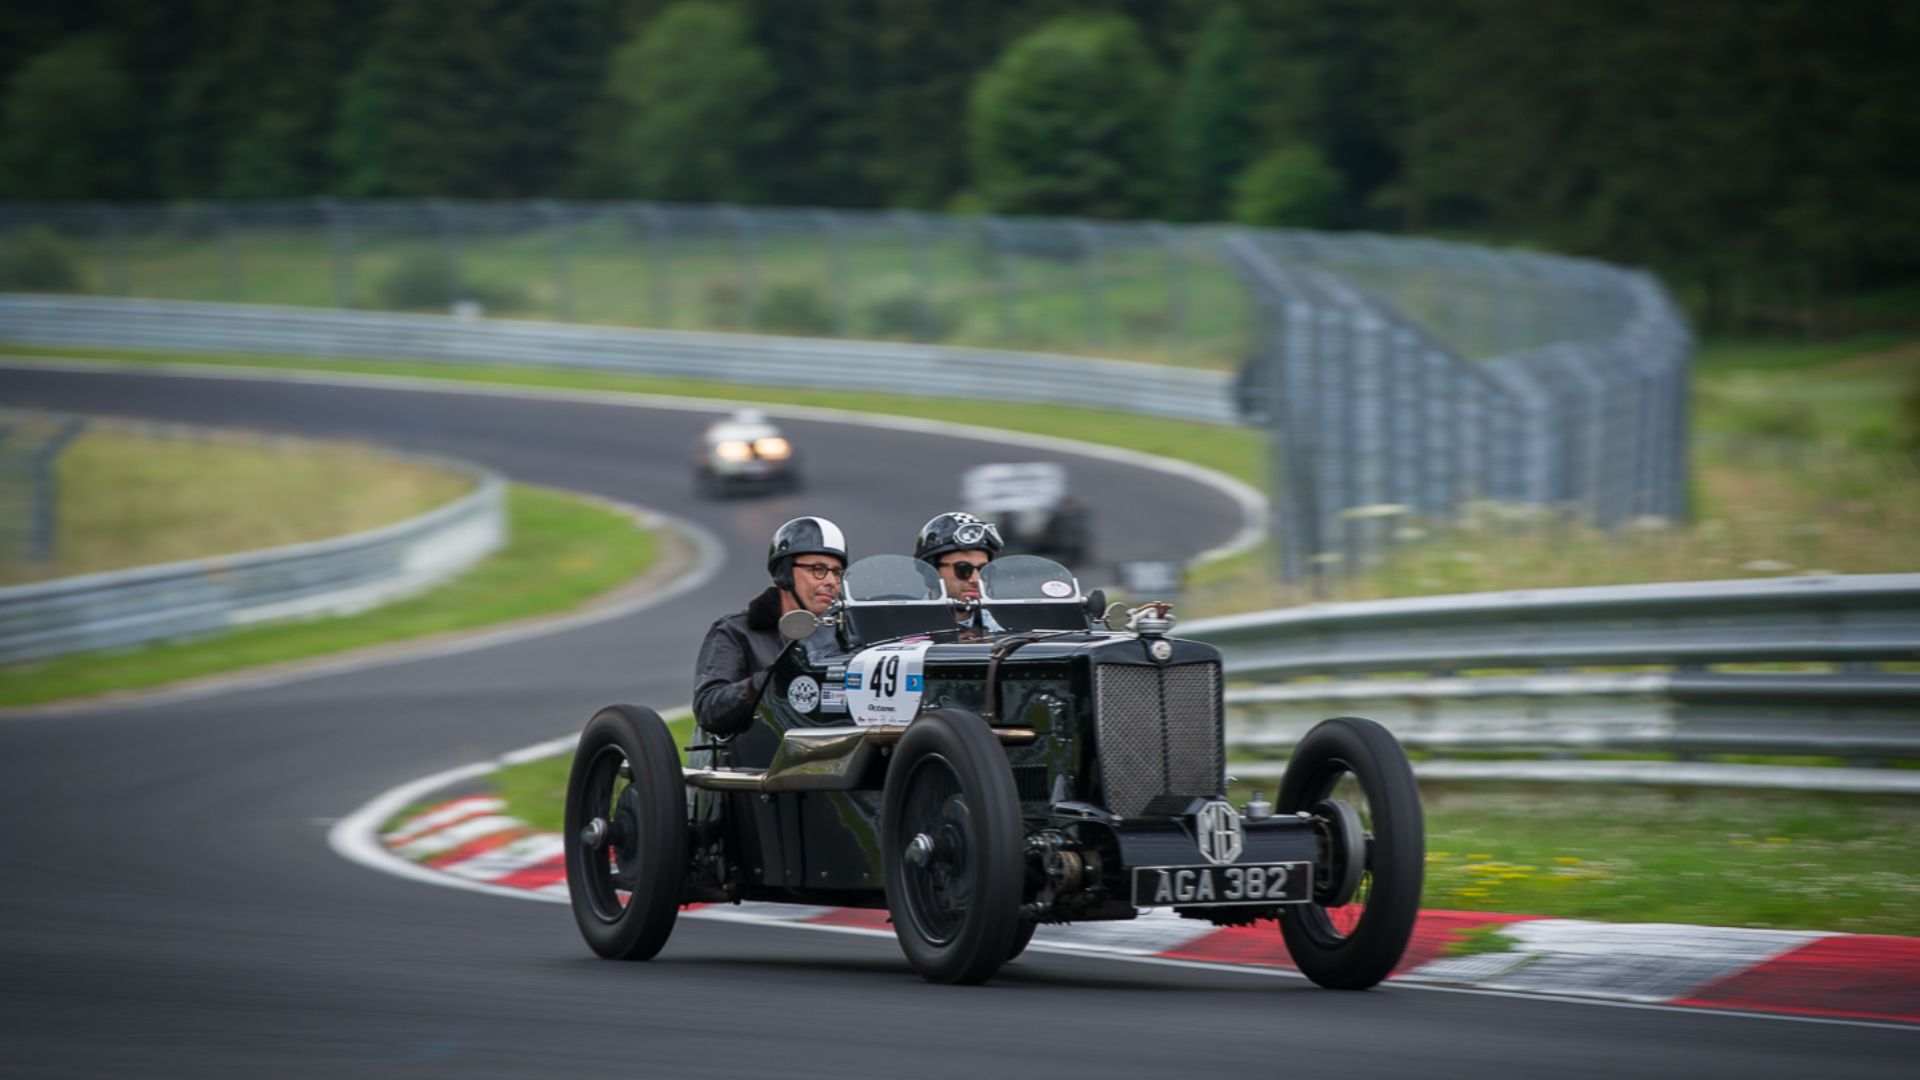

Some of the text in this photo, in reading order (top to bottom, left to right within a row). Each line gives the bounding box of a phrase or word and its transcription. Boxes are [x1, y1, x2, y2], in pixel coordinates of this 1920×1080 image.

[870, 655, 899, 698] 49
[1197, 801, 1242, 864] MG
[1154, 867, 1287, 902] AGA 382
